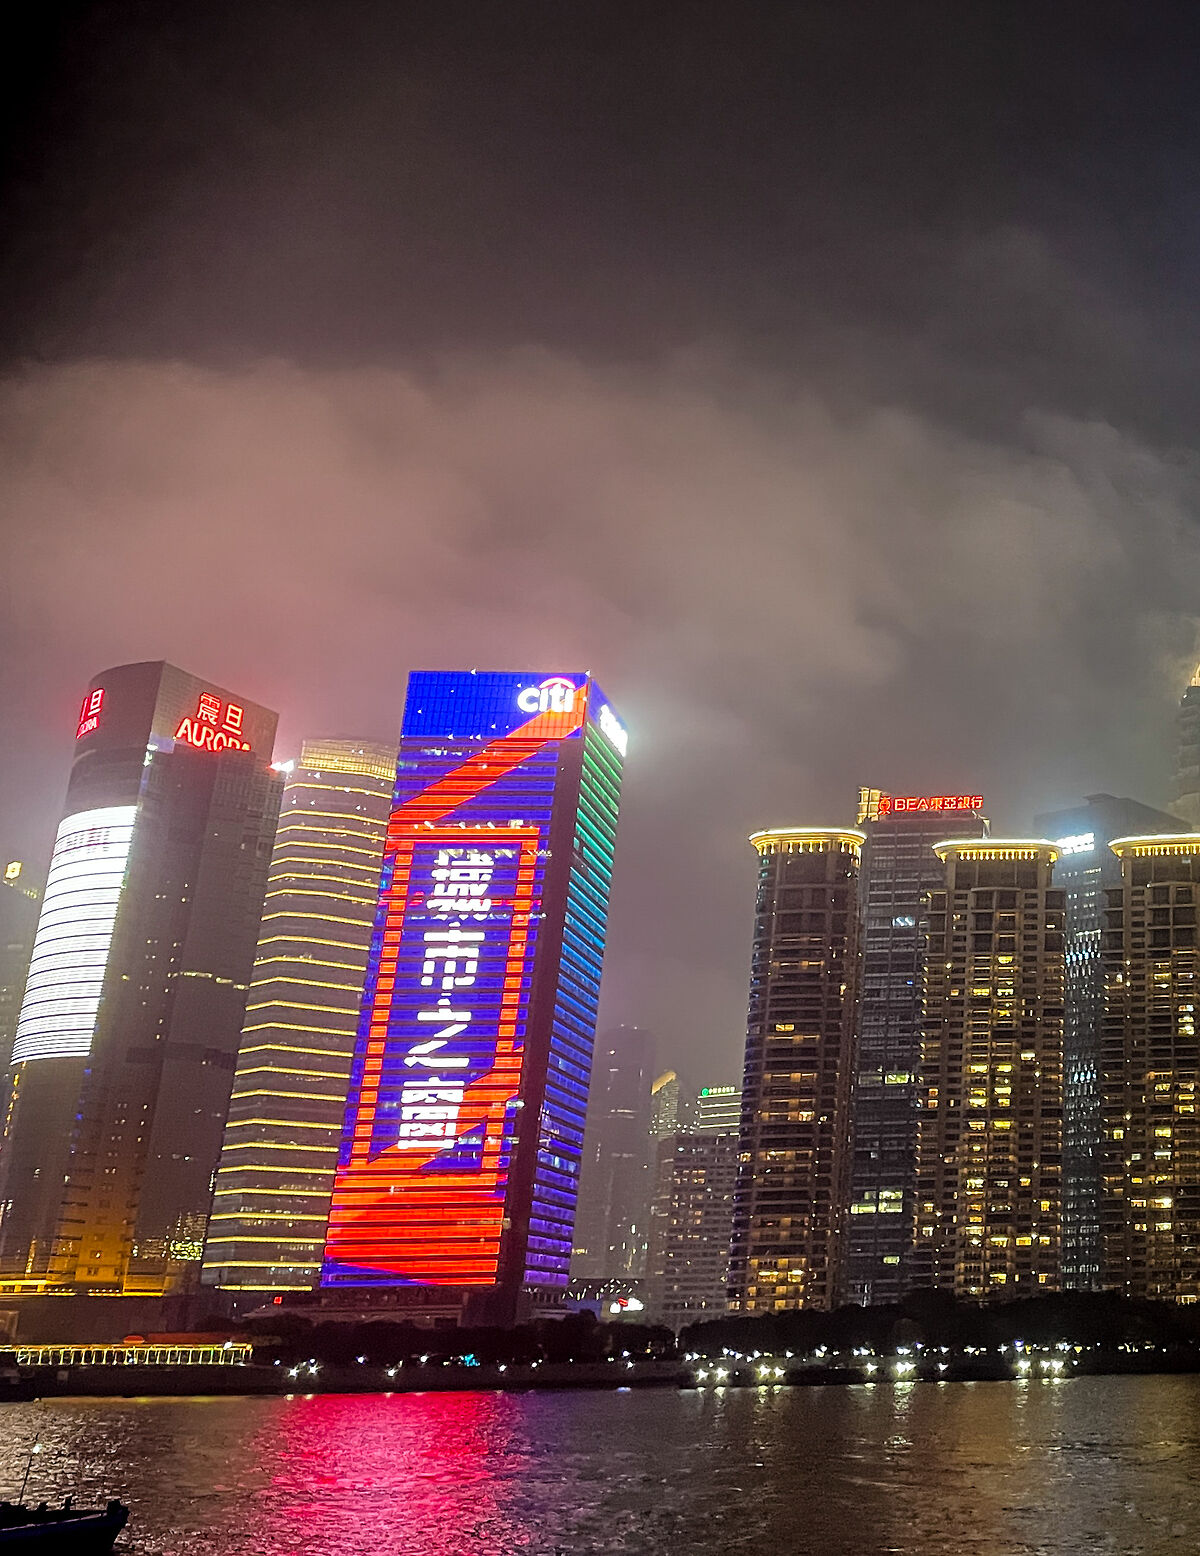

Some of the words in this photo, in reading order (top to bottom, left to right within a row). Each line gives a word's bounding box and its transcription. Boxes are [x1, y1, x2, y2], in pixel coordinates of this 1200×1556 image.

[517, 678, 576, 712] citi
[197, 692, 243, 735] 震旦
[894, 797, 929, 811] BEA
[930, 796, 983, 810] 東亞銀行
